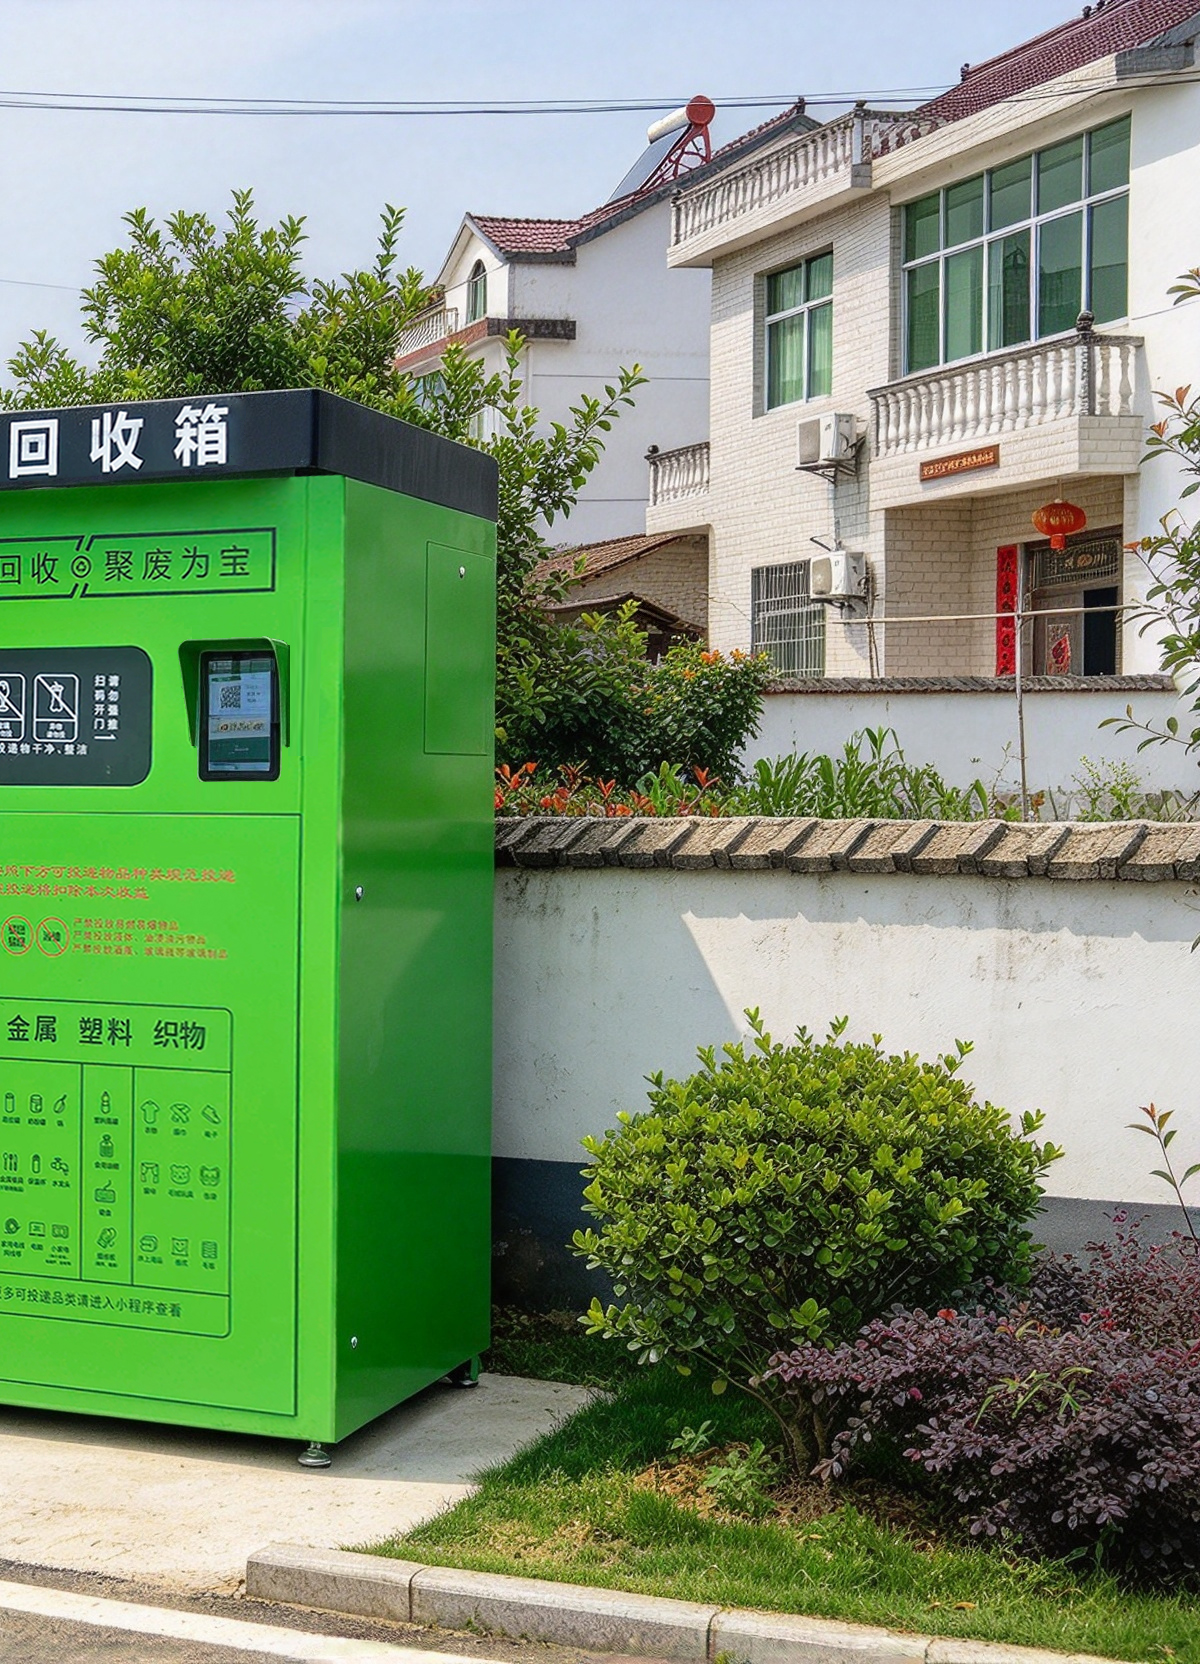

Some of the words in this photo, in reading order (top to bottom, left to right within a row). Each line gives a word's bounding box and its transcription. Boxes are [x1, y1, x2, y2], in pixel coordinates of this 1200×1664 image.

[103, 544, 251, 582] 聚废为宝
[93, 674, 106, 730] 扫码开门
[6, 1014, 58, 1043] 金属
[78, 1016, 133, 1047] 塑料
[153, 1019, 207, 1051] 织物
